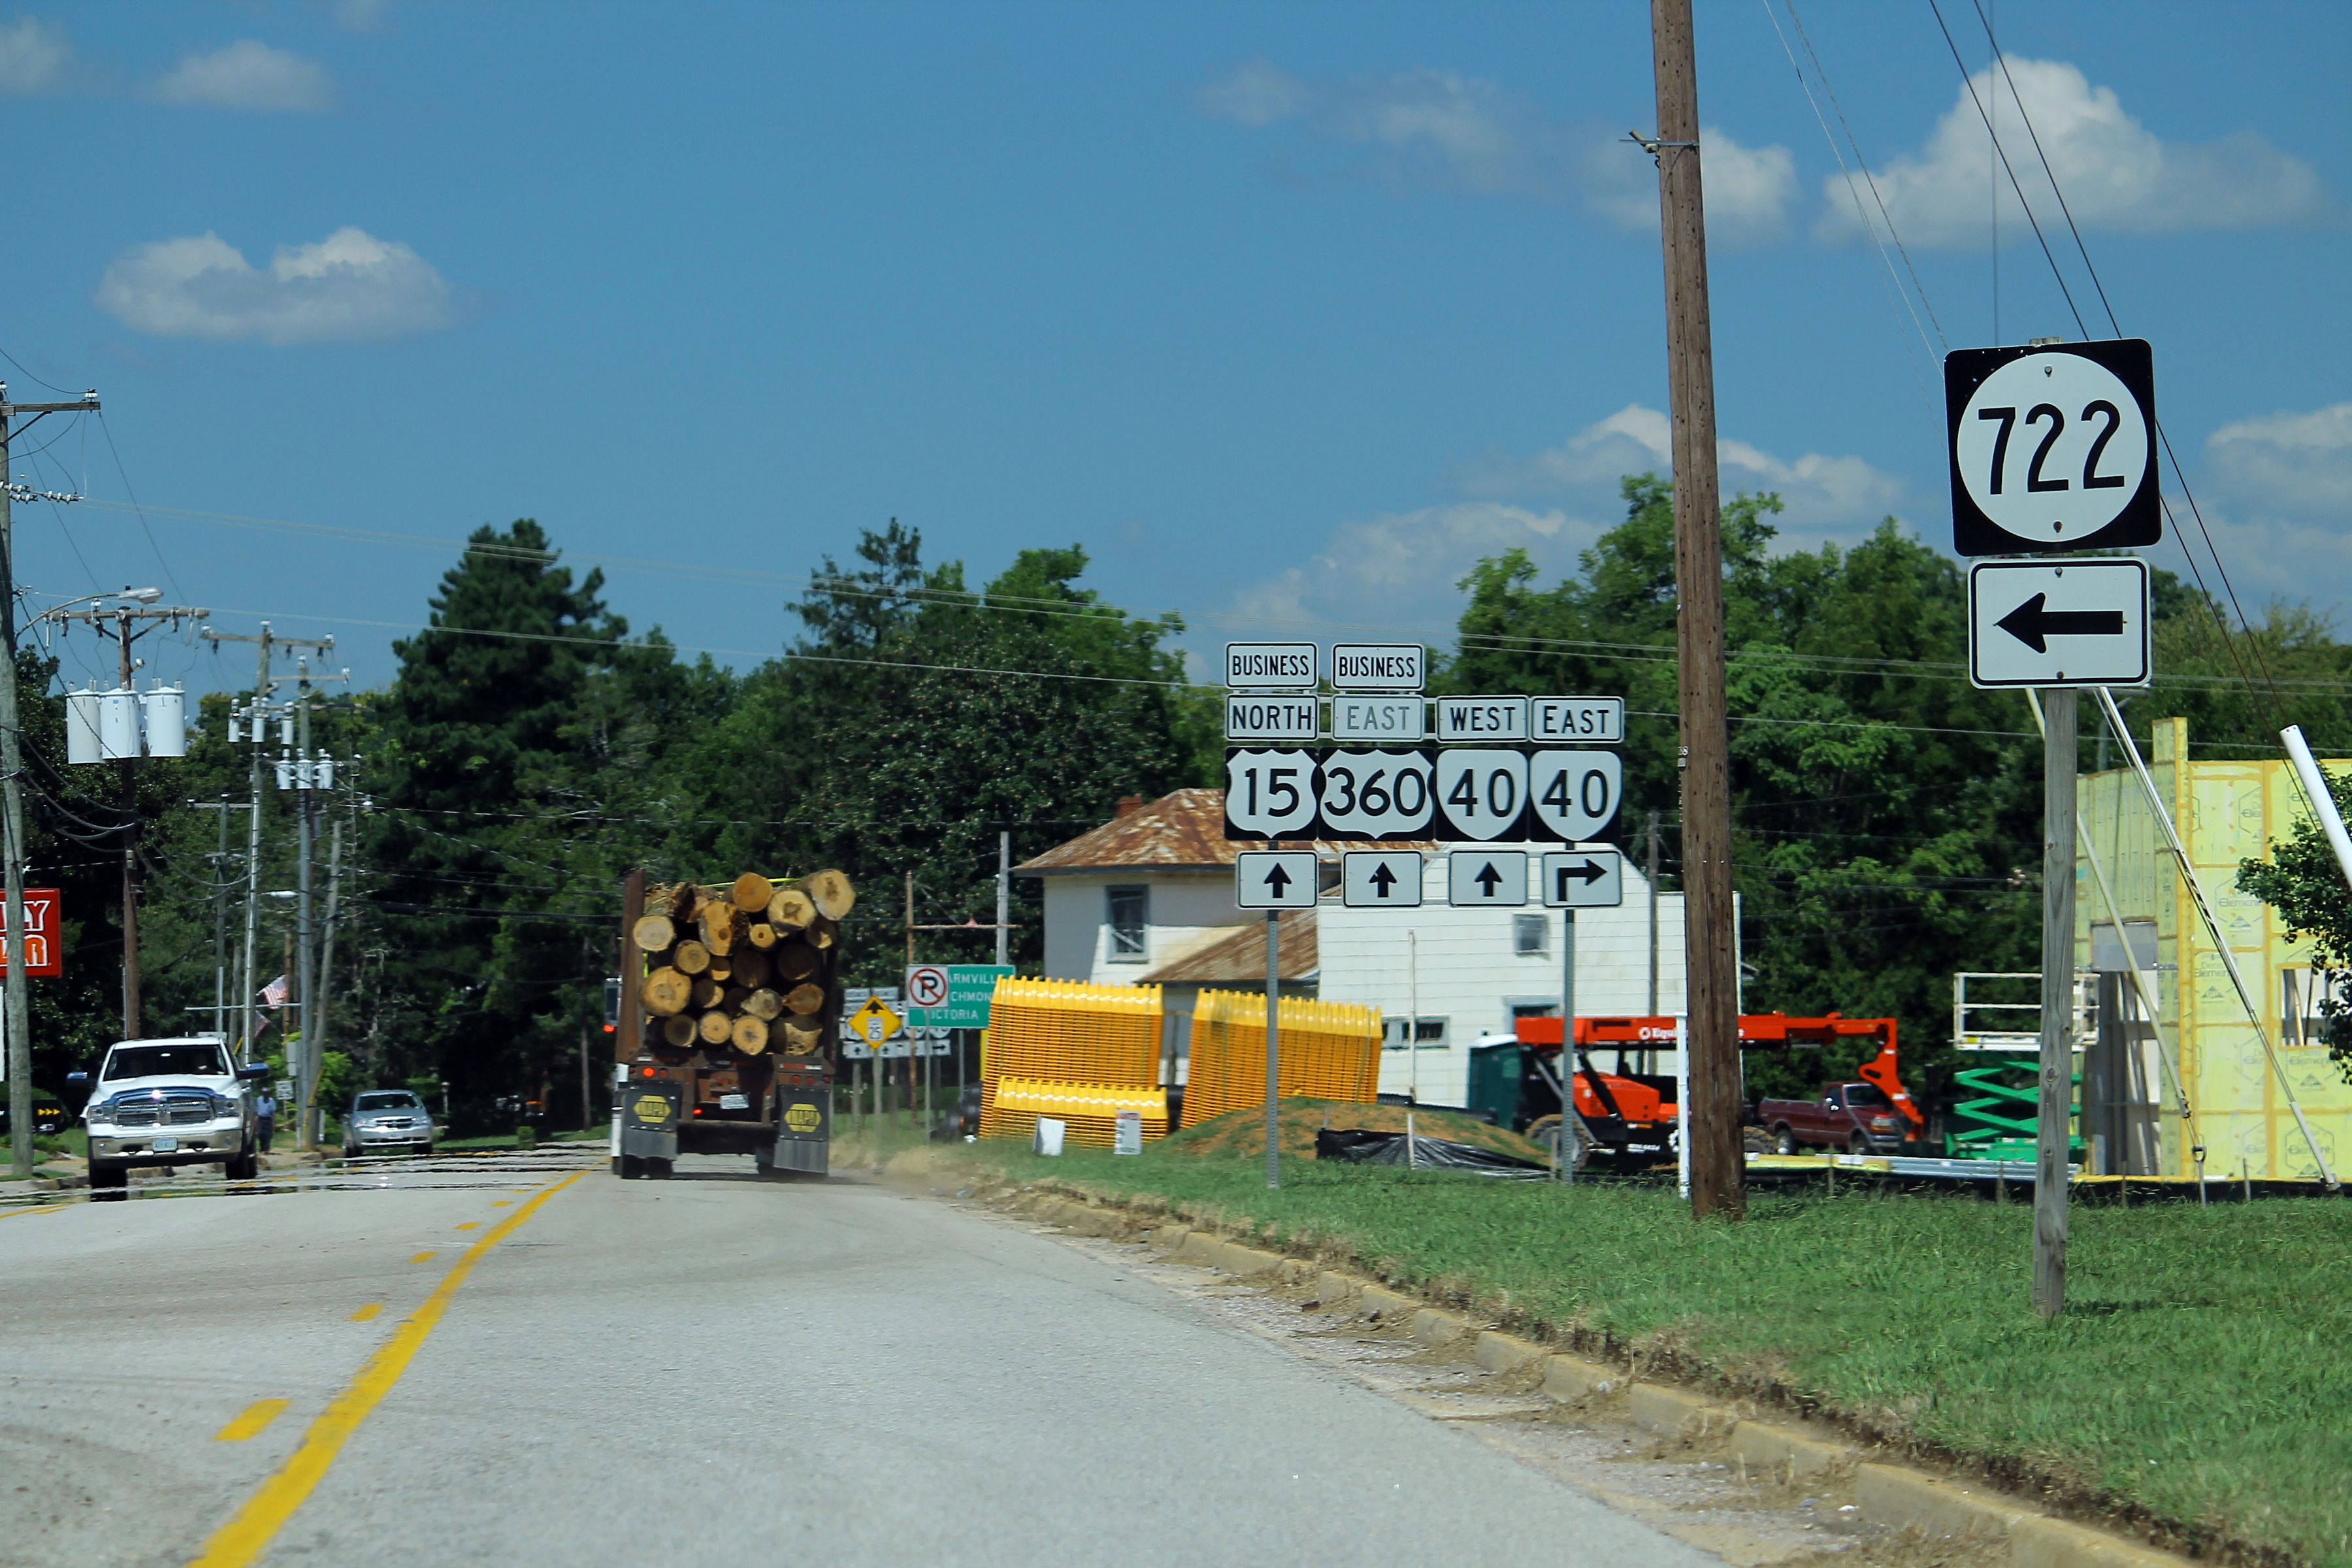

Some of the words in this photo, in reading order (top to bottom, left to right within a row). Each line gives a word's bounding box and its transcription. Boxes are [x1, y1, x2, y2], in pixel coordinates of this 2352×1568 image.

[1978, 399, 2125, 495] 722
[1232, 655, 1309, 676] BUSINESS
[1339, 657, 1415, 678] BUSINESS
[1232, 705, 1313, 730] NORTH
[1347, 706, 1410, 730] EAST
[1449, 706, 1516, 732] WEST
[1543, 705, 1610, 734] EAST
[1245, 767, 1299, 817] 15
[1324, 767, 1426, 817] 360
[1448, 768, 1515, 818] 40
[1541, 769, 1609, 819] 40
[949, 973, 996, 985] ARMVILL
[951, 991, 992, 1002] CHMON
[868, 1026, 881, 1039] 25
